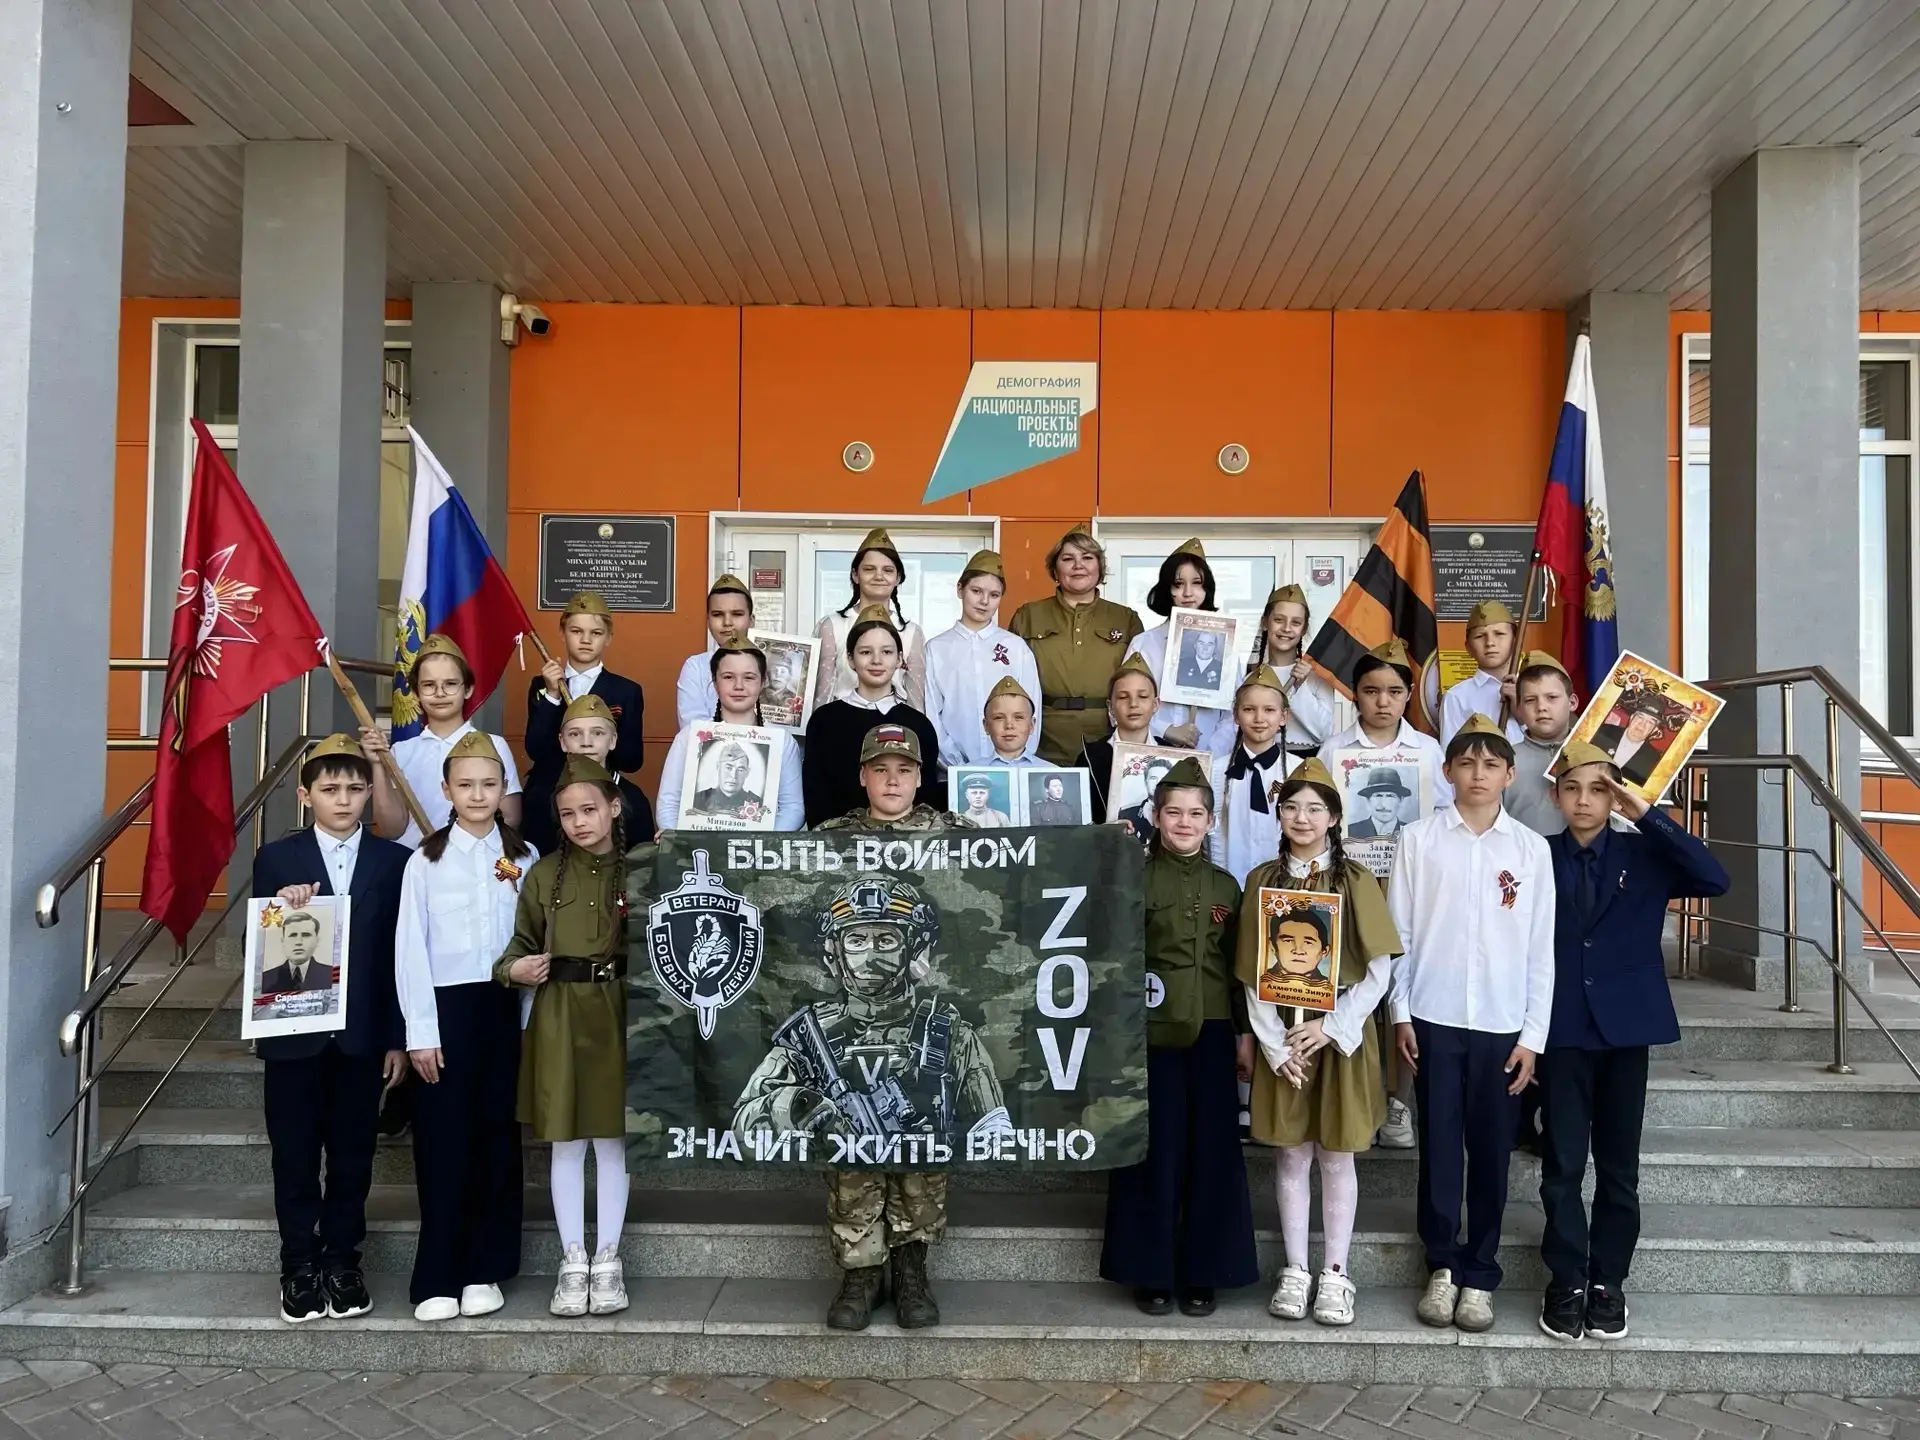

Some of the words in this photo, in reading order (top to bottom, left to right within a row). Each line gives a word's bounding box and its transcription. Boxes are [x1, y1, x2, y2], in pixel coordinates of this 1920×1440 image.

[996, 377, 1081, 389] ДЕМОГРАФИЯ
[972, 399, 1078, 416] НАЦИОНАЛЬНЫЕ
[1017, 416, 1078, 431] ПРОЕКТЫ
[1028, 433, 1078, 448] РОССИИ
[566, 558, 619, 566] МИХАЙЛОВКА
[1464, 567, 1517, 575] ОБРАЗОВАНИЯ
[1456, 580, 1508, 588] МИХАЙЛОВКА
[706, 816, 747, 828] Мингазов
[726, 838, 845, 871] БЫТЬ
[856, 836, 1036, 872] ВОИНОМ
[672, 895, 737, 911] ВЕТЕРАН
[655, 932, 692, 993] БОЕВЫХ
[723, 930, 756, 998] ДЕЙСТВИЙ
[666, 1126, 815, 1162] ЗНАЧИТ
[826, 1132, 954, 1165] ЖИТЬ
[965, 1126, 1097, 1162] ВЕЧНО
